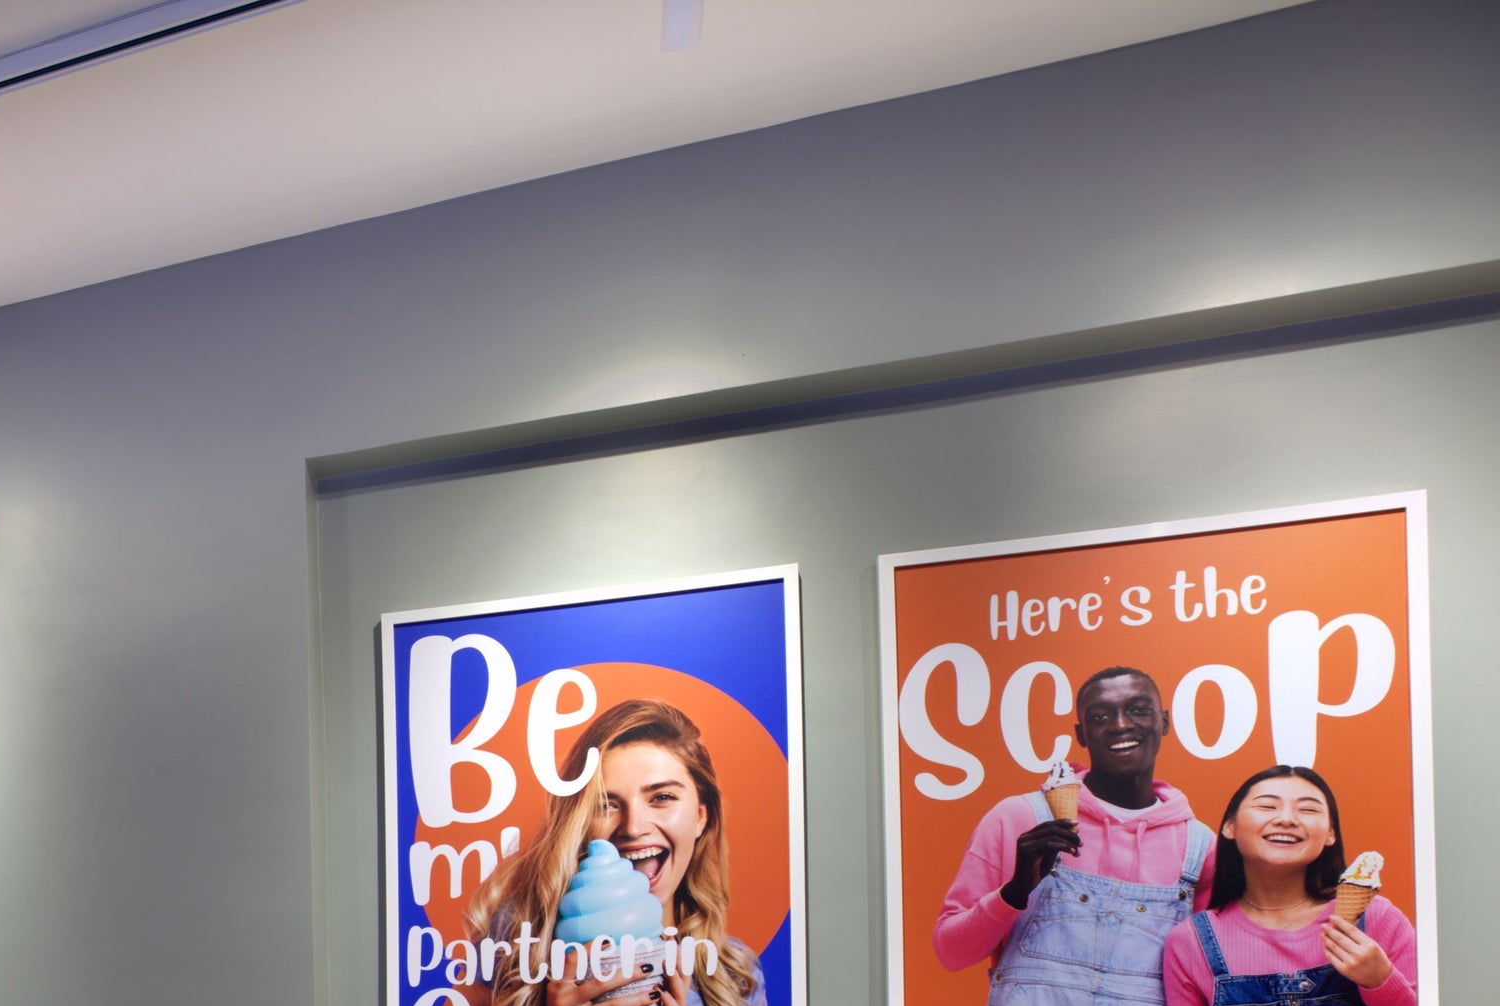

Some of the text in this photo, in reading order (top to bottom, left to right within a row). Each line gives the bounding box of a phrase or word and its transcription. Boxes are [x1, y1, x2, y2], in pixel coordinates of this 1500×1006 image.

[990, 566, 1267, 641] Here's the
[409, 633, 600, 828] Be
[899, 609, 1396, 801] Scop
[409, 826, 520, 906] m
[663, 926, 719, 977] in
